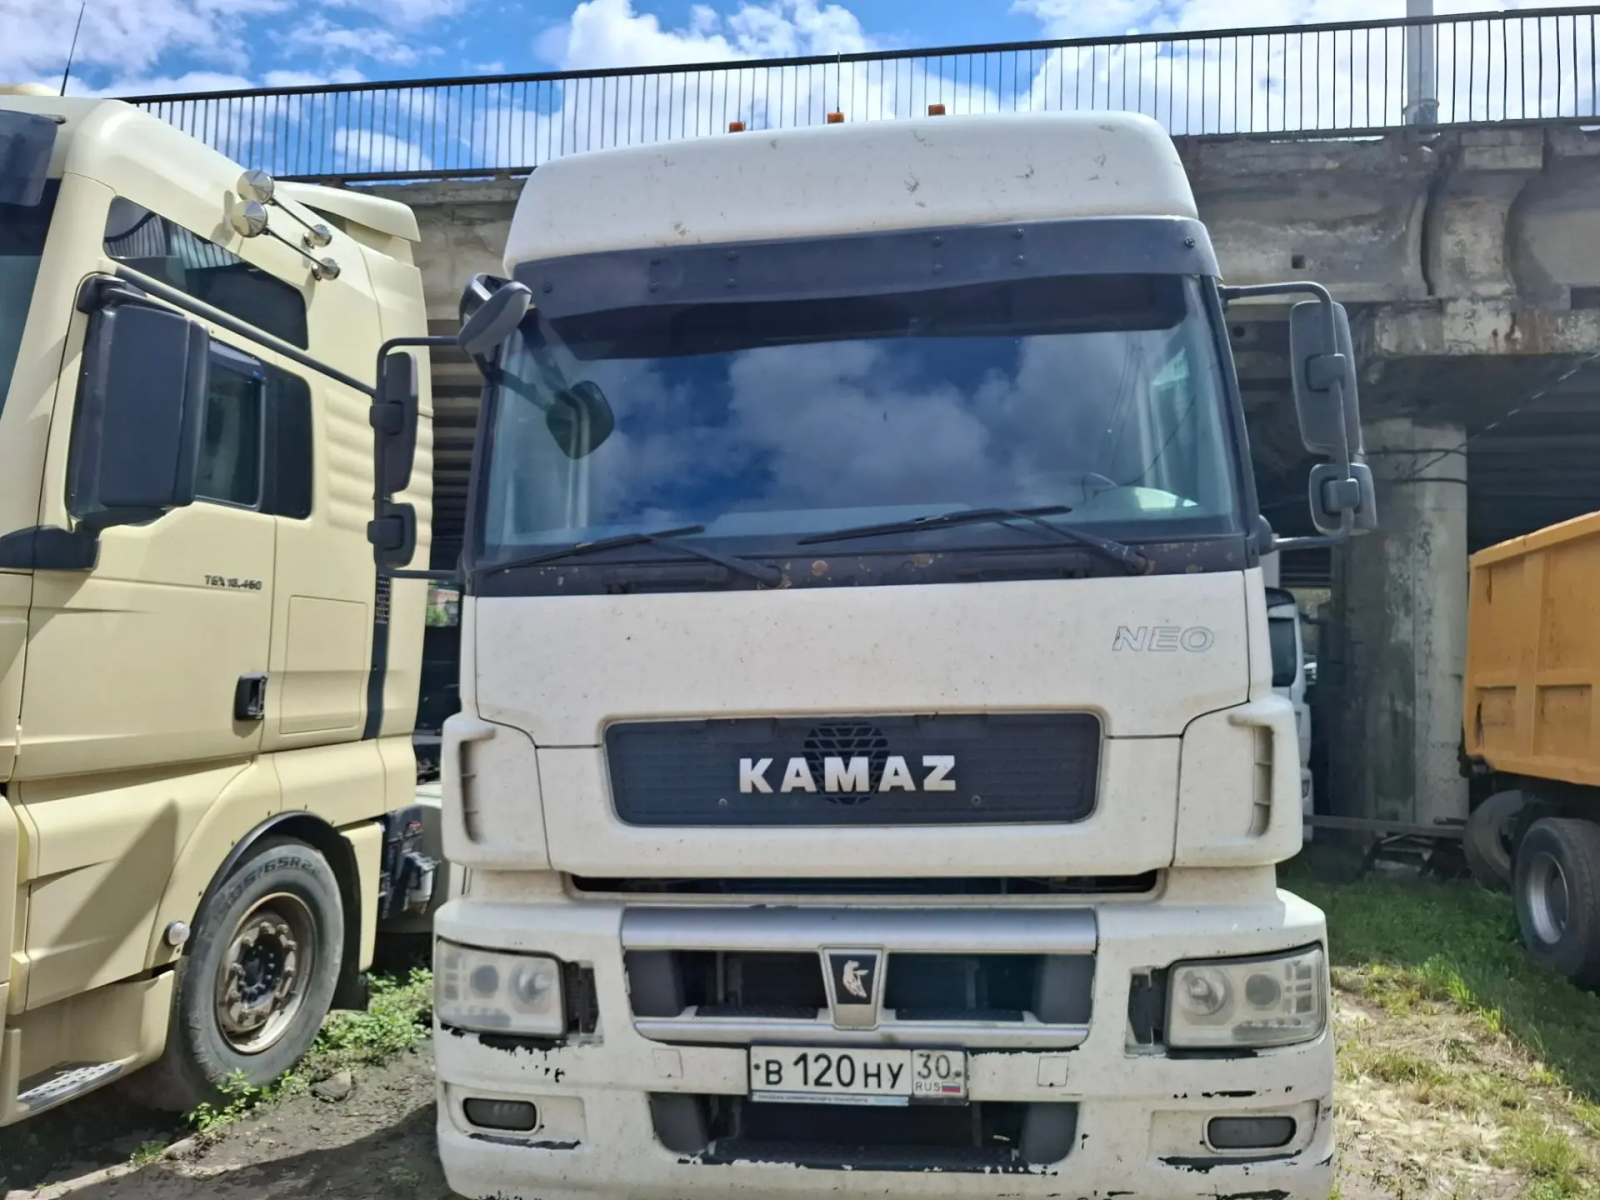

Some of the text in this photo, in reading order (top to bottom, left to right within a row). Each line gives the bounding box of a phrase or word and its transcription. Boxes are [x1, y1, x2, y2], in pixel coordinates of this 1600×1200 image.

[1112, 625, 1215, 653] NEO
[739, 754, 956, 794] KAMAZ
[917, 1052, 950, 1080] 30
[914, 1081, 941, 1092] RUS
